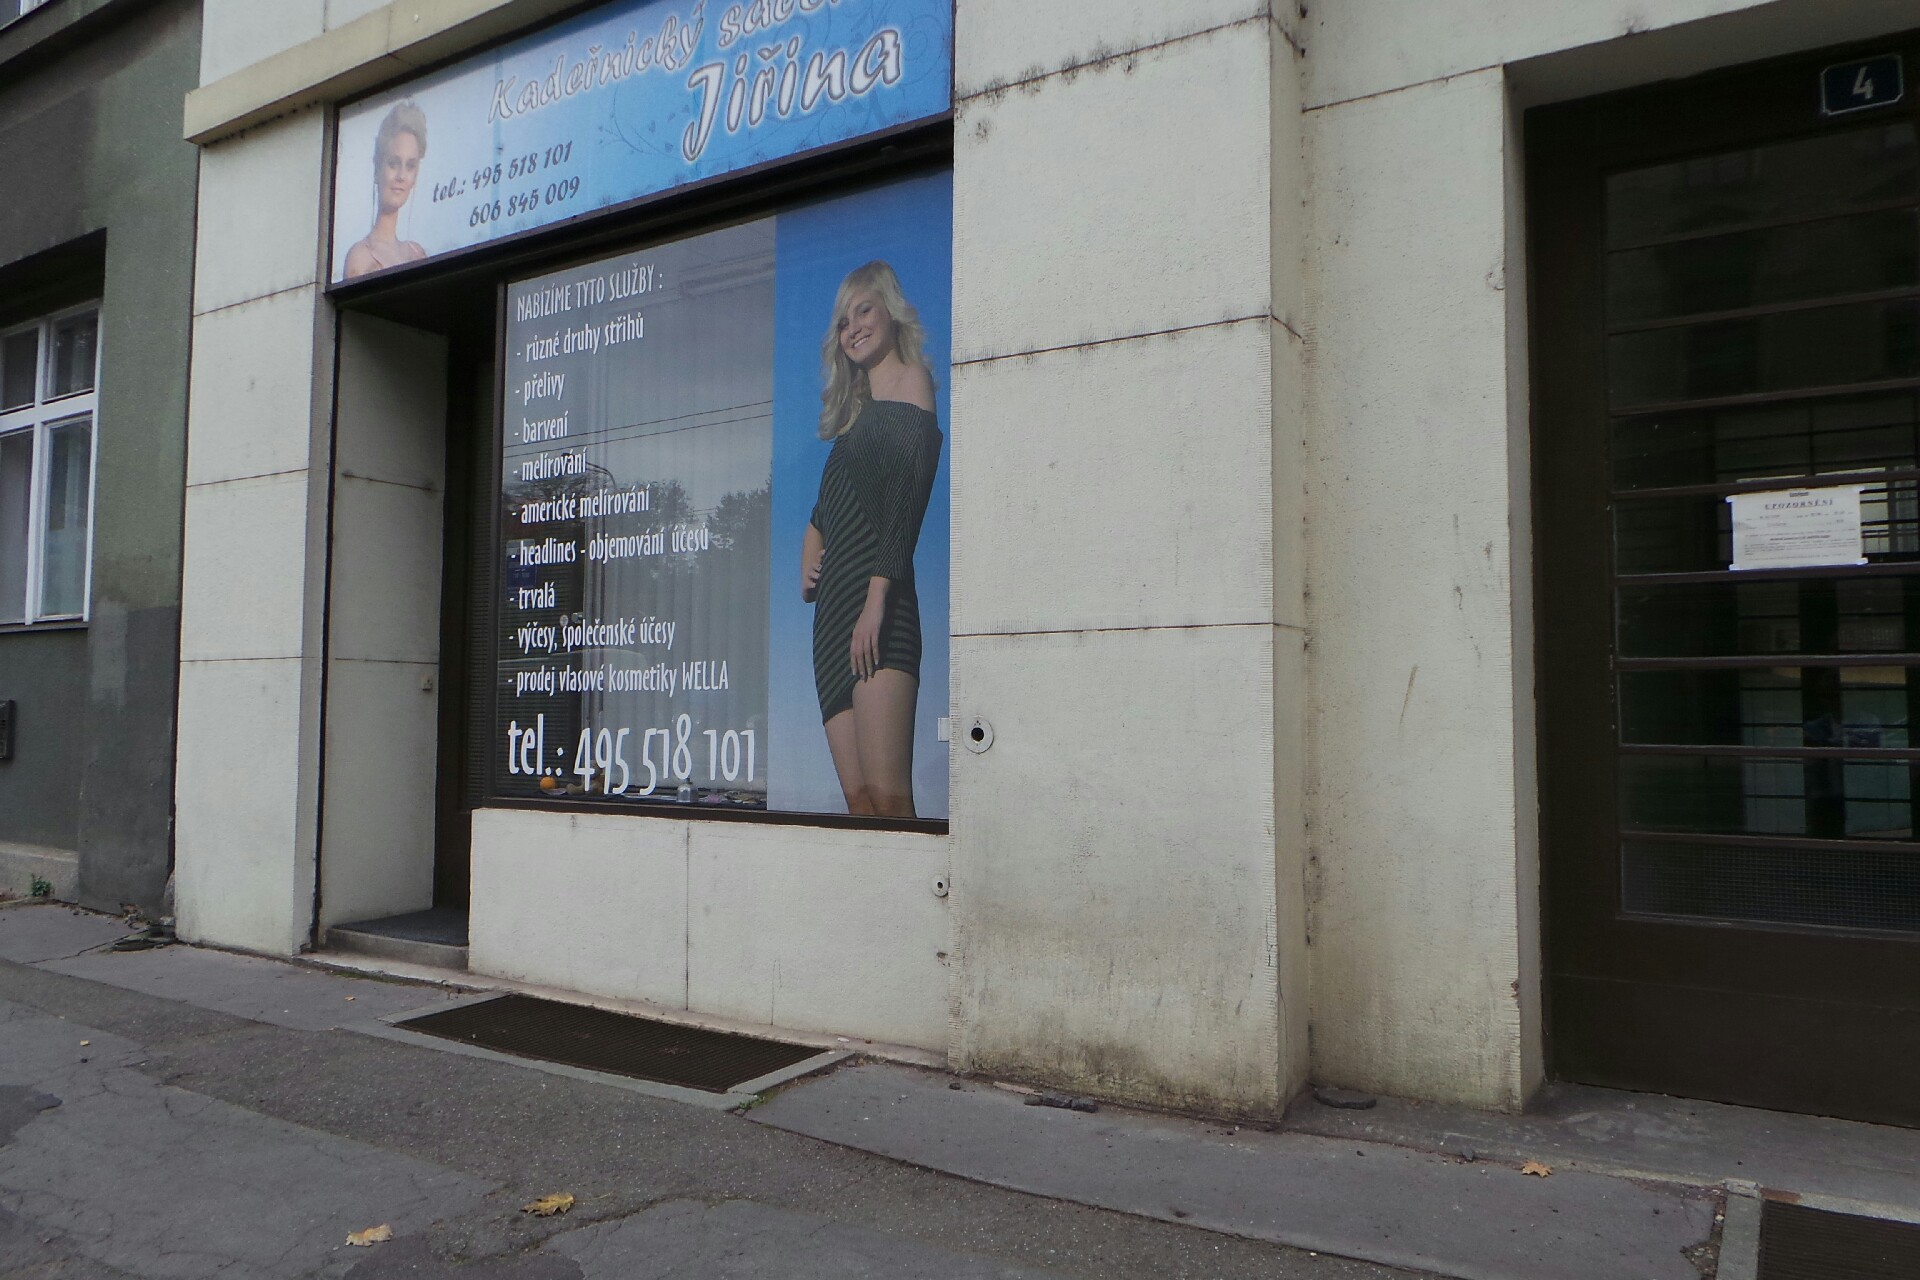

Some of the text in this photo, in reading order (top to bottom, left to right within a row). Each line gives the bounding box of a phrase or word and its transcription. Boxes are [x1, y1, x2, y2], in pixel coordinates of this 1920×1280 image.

[487, 1, 705, 124] Kadeřnický
[1852, 65, 1874, 99] 4
[682, 29, 901, 162] Jiřina
[472, 163, 502, 190] 495
[508, 152, 538, 180] 518
[543, 140, 573, 169] 101
[469, 175, 581, 228] 606 845 009
[516, 283, 572, 323] NABÍZÍME
[575, 277, 605, 309] TYTO
[609, 262, 655, 302] SLUŽBY
[525, 330, 560, 363] různé
[563, 323, 600, 355] druhy
[604, 311, 645, 346] střihů
[523, 372, 565, 406] přelivy
[522, 410, 569, 444] barvení
[521, 446, 588, 482] melírování
[520, 491, 577, 525] americké
[579, 483, 651, 521] melírování
[519, 537, 577, 567] headlines
[588, 528, 665, 565] objemování
[671, 525, 709, 554] účesů
[518, 581, 556, 610] trvalá
[562, 617, 636, 653] společenské
[639, 615, 676, 651] účesy
[516, 664, 556, 698] prodej
[558, 663, 605, 692] vlasové
[608, 662, 678, 698] kosmetiky
[681, 659, 729, 690] WELLA
[507, 713, 756, 796] tel.: 495 518 101
